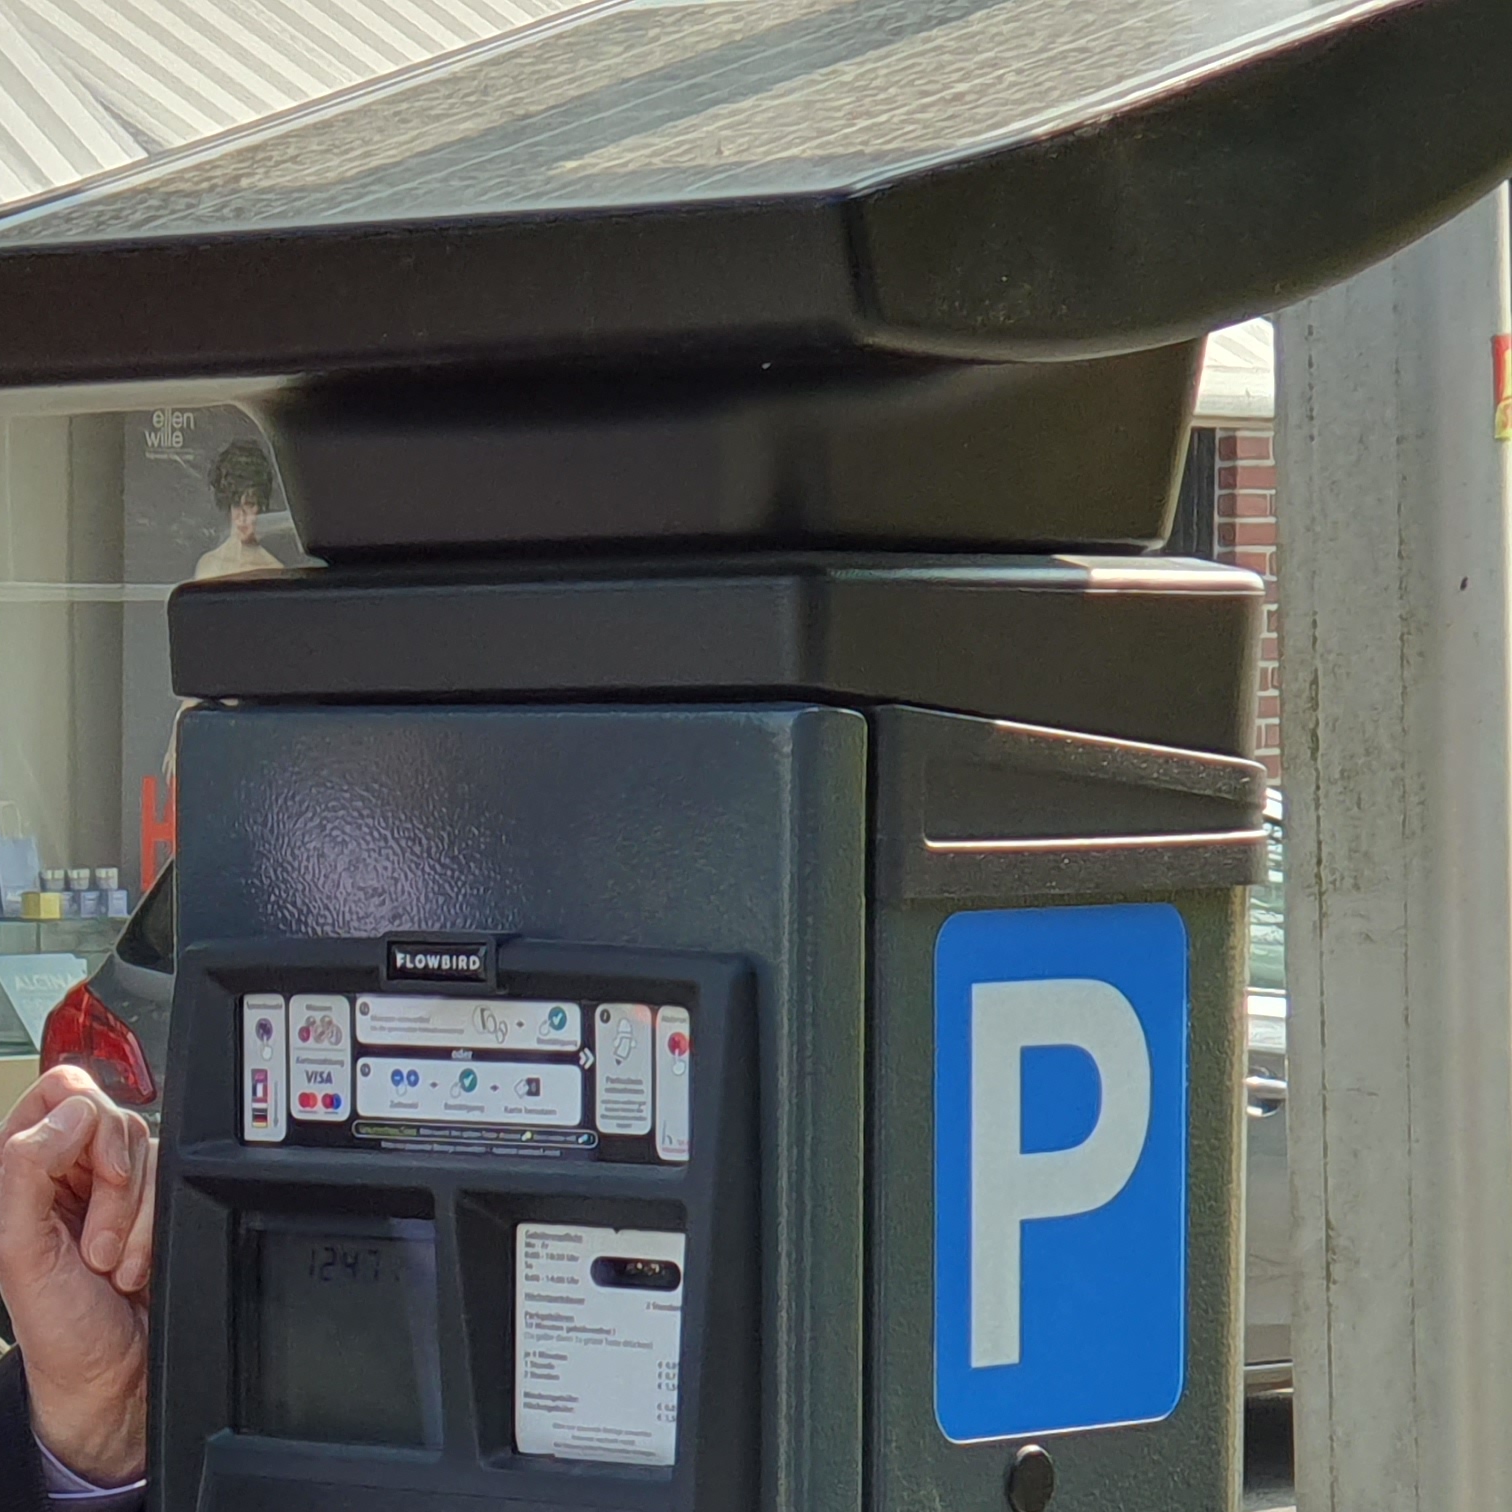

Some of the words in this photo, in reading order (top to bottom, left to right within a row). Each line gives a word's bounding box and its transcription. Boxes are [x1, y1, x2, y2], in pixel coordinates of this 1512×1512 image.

[152, 408, 195, 430] ellen
[144, 427, 184, 448] wille
[395, 952, 481, 971] FLOWBIRD
[304, 1069, 334, 1085] VISA
[971, 978, 1151, 1369] P
